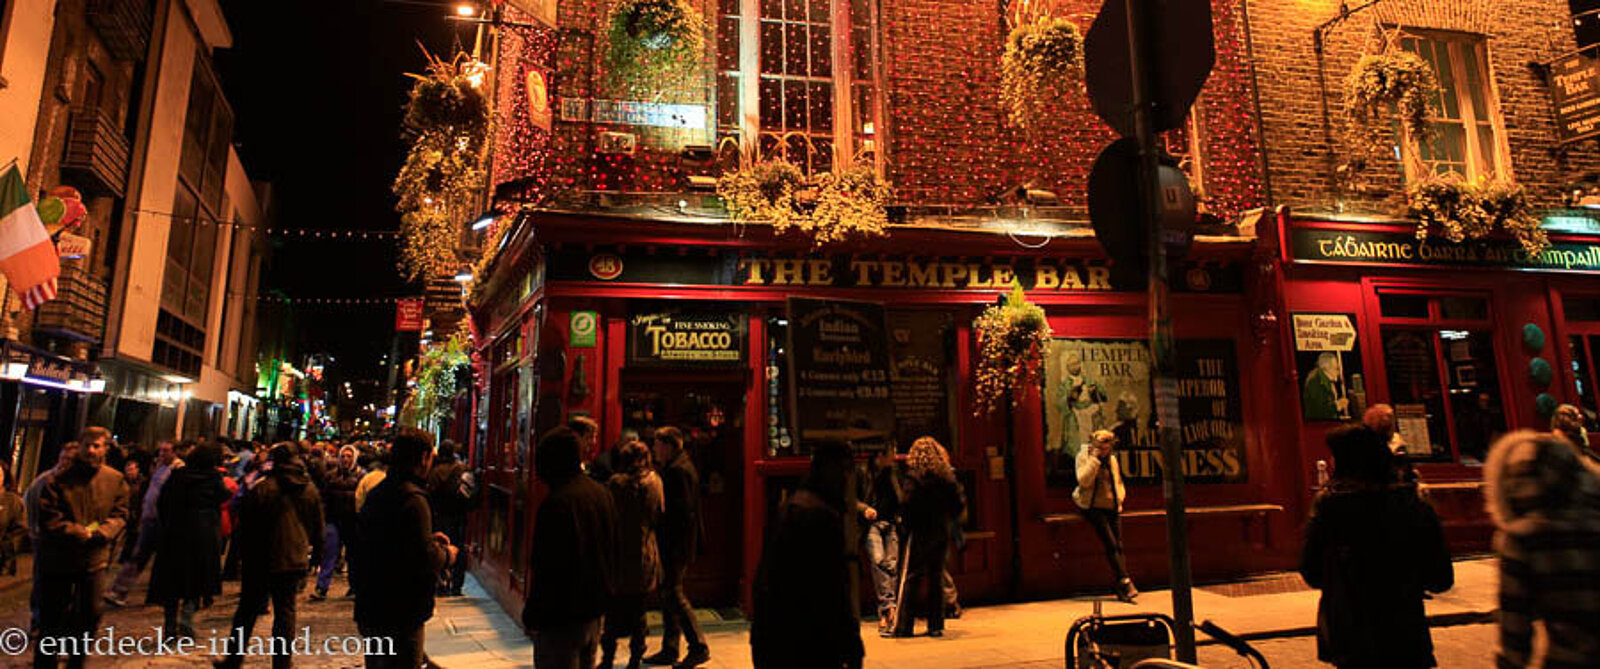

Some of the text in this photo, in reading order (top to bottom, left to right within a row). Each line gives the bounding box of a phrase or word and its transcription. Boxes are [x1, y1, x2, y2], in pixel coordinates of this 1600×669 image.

[740, 259, 1111, 290] THE TEMPLE BAR
[675, 321, 732, 330] FINE SMOKING
[1296, 317, 1313, 328] Beer
[1315, 317, 1343, 328] Garden
[645, 325, 732, 356] TOBACCO
[1297, 329, 1329, 341] Smoking
[1081, 347, 1148, 362] TEMPLE
[1100, 363, 1132, 378] BAR
[1197, 357, 1225, 377] THE
[1177, 378, 1226, 398] MPEROR
